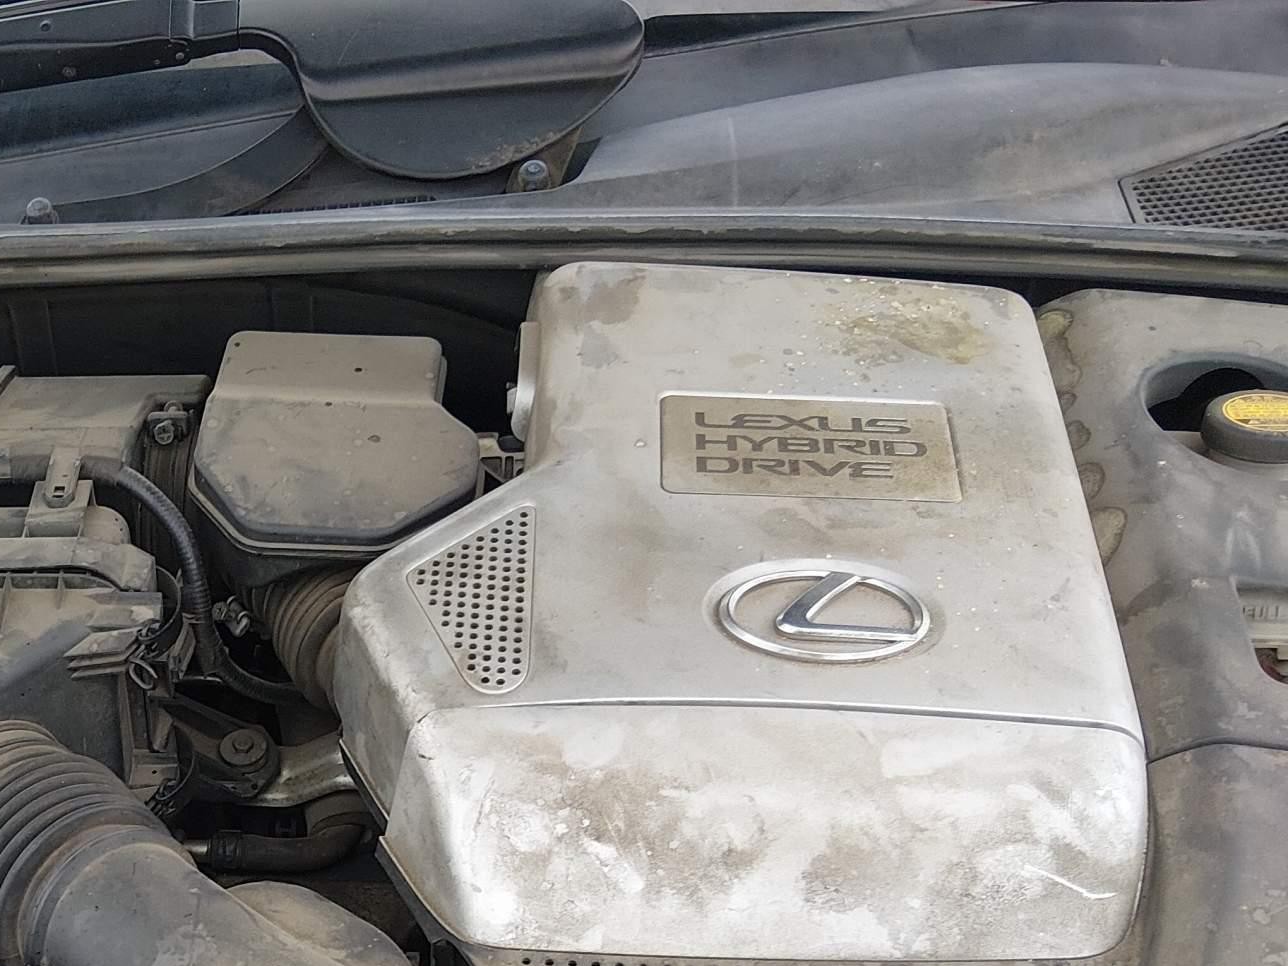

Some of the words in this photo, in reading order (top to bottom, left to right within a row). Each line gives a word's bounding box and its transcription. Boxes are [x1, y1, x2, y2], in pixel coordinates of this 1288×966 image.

[695, 411, 912, 434] LEXUS
[695, 433, 928, 458] HYBRID
[695, 455, 895, 480] DRIVE
